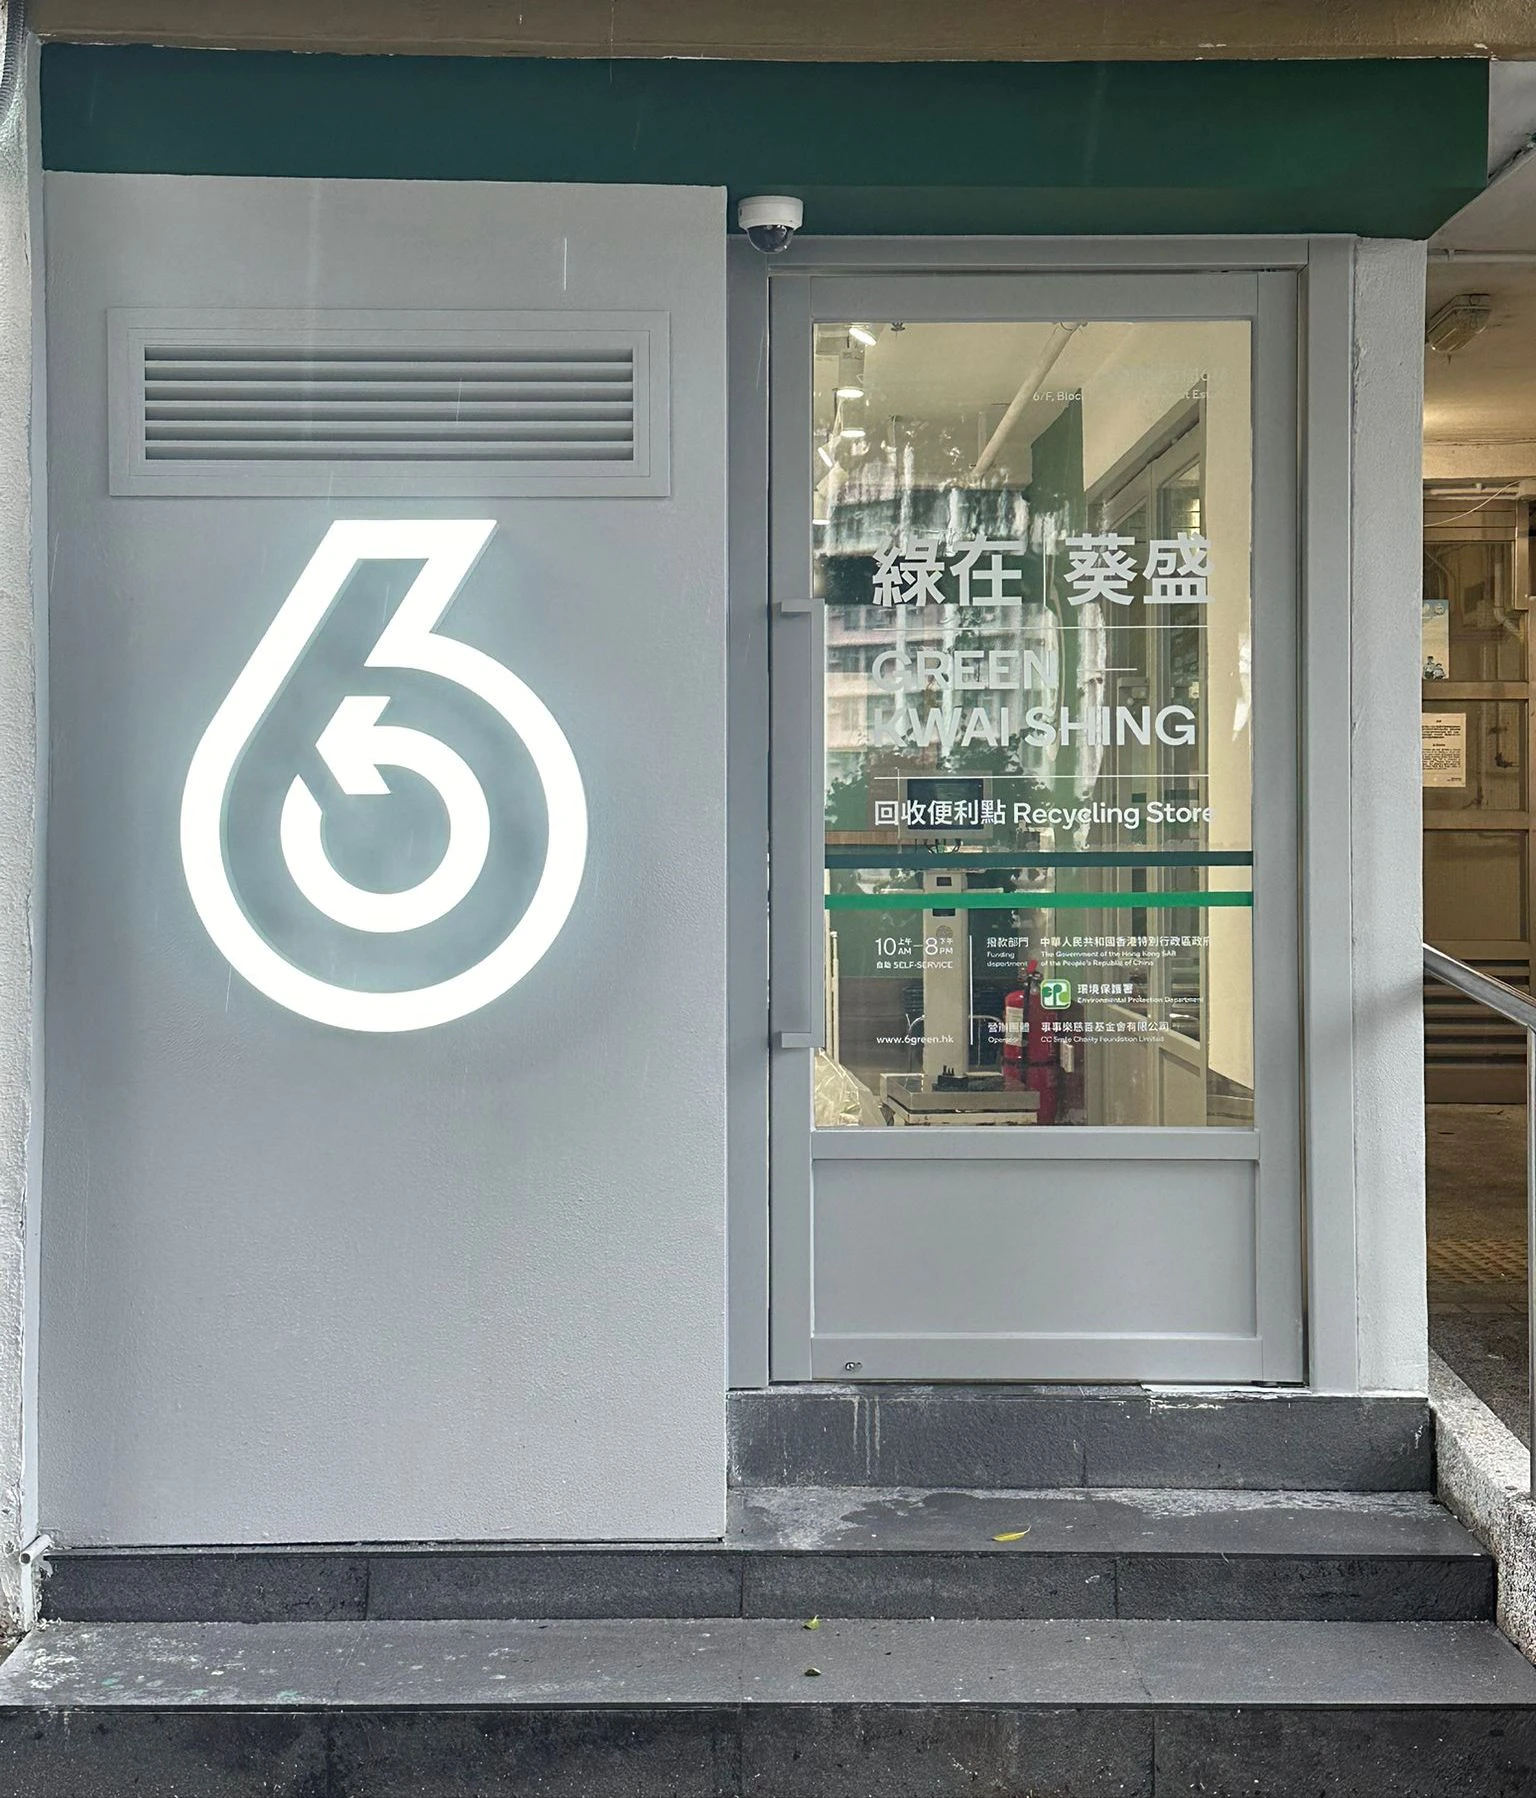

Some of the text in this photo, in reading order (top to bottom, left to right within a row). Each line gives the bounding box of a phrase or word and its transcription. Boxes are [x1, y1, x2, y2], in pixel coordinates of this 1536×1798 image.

[1057, 391, 1082, 401] Bloc
[872, 532, 1214, 607] 綠在 葵盛
[871, 649, 1059, 692] GREEN
[873, 704, 1196, 748] KWAI SHING
[180, 519, 588, 1032] 6
[874, 799, 1214, 830] 回收便利點 Recycling Store
[875, 937, 938, 956] 10 8
[898, 947, 953, 955] AM PM
[986, 951, 1015, 960] Funding
[893, 961, 953, 969] SELF-SERVICE
[876, 1034, 954, 1046] www.6green.hk
